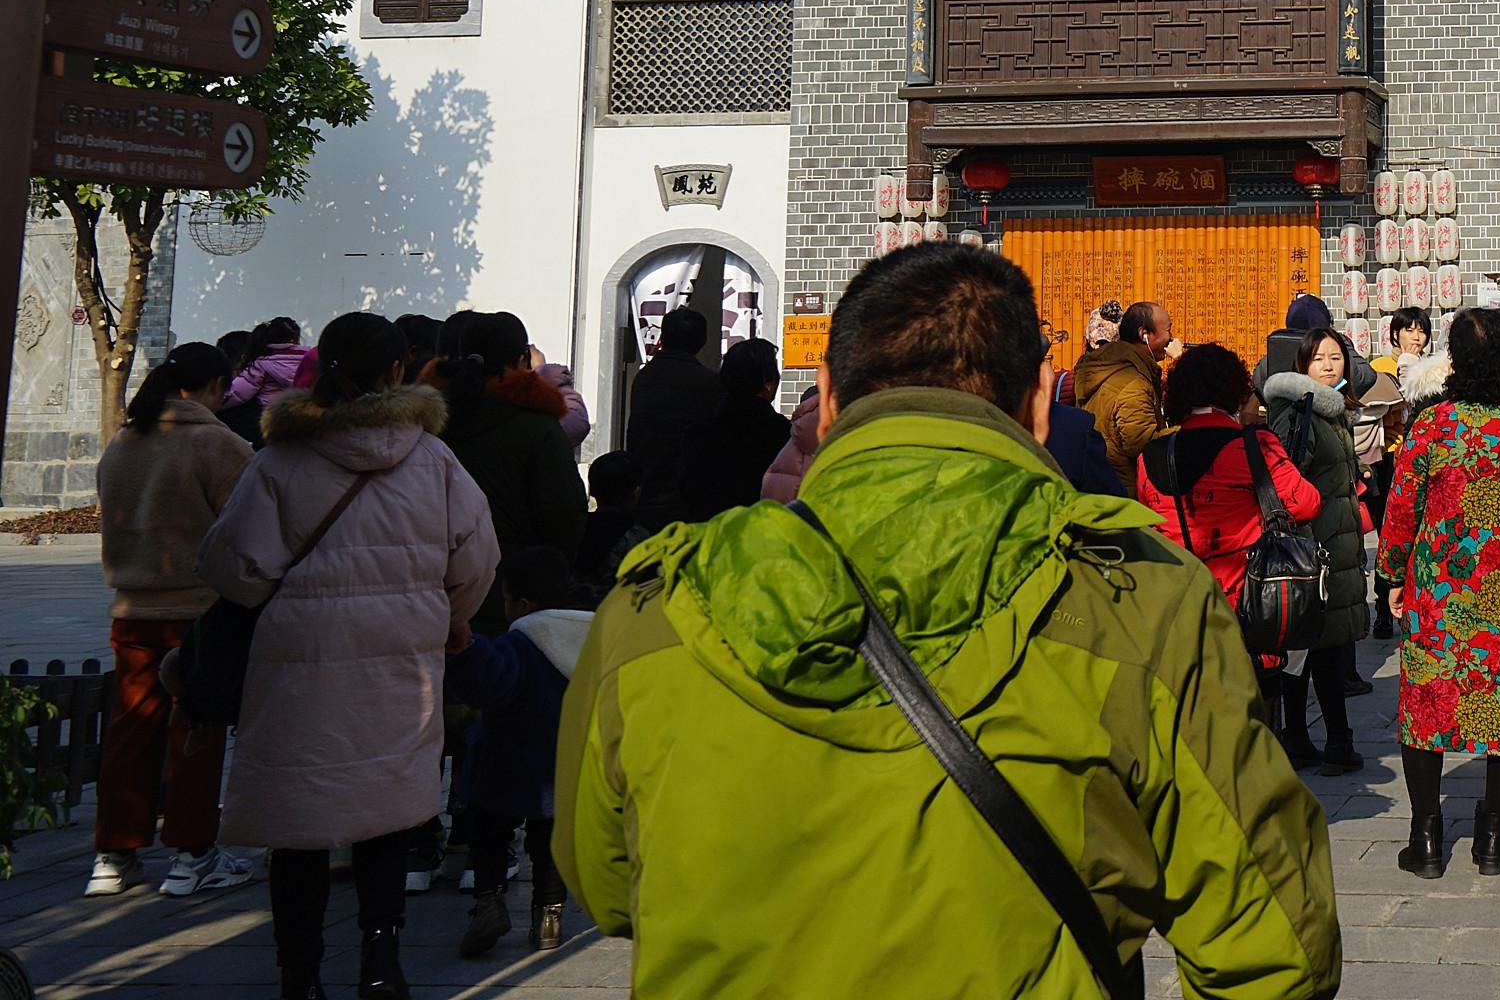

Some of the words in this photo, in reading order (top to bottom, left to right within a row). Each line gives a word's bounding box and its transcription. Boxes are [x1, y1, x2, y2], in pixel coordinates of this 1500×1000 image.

[145, 17, 180, 39] Winery
[55, 130, 85, 148] Lucky
[86, 133, 124, 152] Building
[1118, 166, 1217, 195] 摔碗酒
